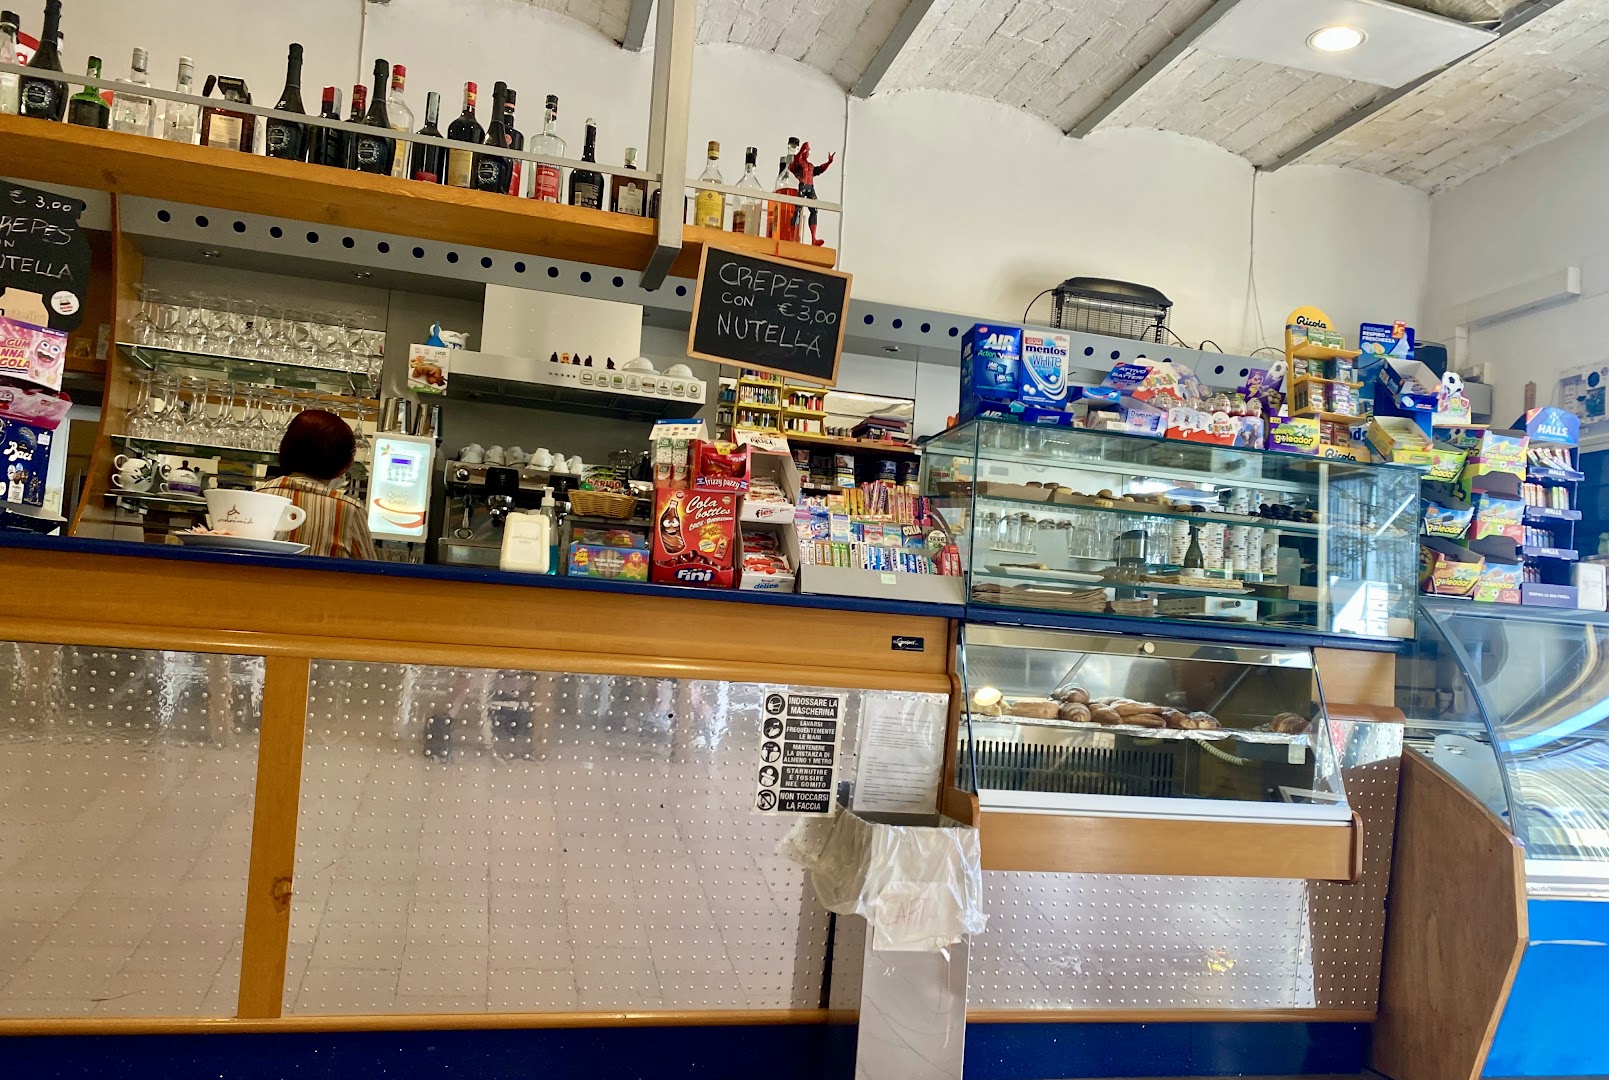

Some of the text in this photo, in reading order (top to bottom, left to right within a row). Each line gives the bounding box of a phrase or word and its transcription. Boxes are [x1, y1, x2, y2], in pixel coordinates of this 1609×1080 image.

[9, 189, 27, 204] €
[0, 215, 75, 245] REPES
[719, 262, 824, 302] CREPES
[721, 291, 755, 307] CON
[777, 302, 836, 325] € 3,00
[1296, 315, 1327, 329] Ricola
[717, 311, 821, 358] NUTELLA
[6, 338, 31, 348] GUM
[983, 333, 1015, 351] AIR
[0, 347, 25, 358] NNA
[978, 349, 997, 358] Action
[1025, 345, 1067, 356] mentos
[0, 359, 31, 369] GOLA
[1119, 366, 1146, 374] ATTIVO
[1112, 372, 1144, 380] BATTERI
[1537, 424, 1568, 436] HALLS
[1275, 433, 1313, 445] goleador
[3, 440, 34, 461] Baci
[1325, 448, 1357, 461] Ricola
[1431, 467, 1456, 478] leador
[586, 478, 622, 489] HARIBO
[704, 477, 740, 490] frizzy pazzy
[686, 495, 718, 514] Cola
[695, 506, 731, 520] bottles
[1428, 524, 1463, 534] goleador
[677, 569, 713, 581] Fini
[1435, 578, 1469, 586] goleador
[788, 696, 838, 708] INDOSSARE LA
[790, 706, 835, 717] MASCHERINA
[800, 720, 824, 728] LAVARSI
[786, 726, 835, 735] FREQUENTEMENTE
[792, 743, 826, 752] MANTENERE
[795, 750, 823, 758] DISTANZA
[783, 756, 807, 764] ALMENO
[786, 767, 828, 775] STARNUTIRE
[784, 780, 827, 789] NEL GOMITO
[779, 792, 829, 802] NON TOCCARSI
[786, 801, 821, 810] LA FACCIA
